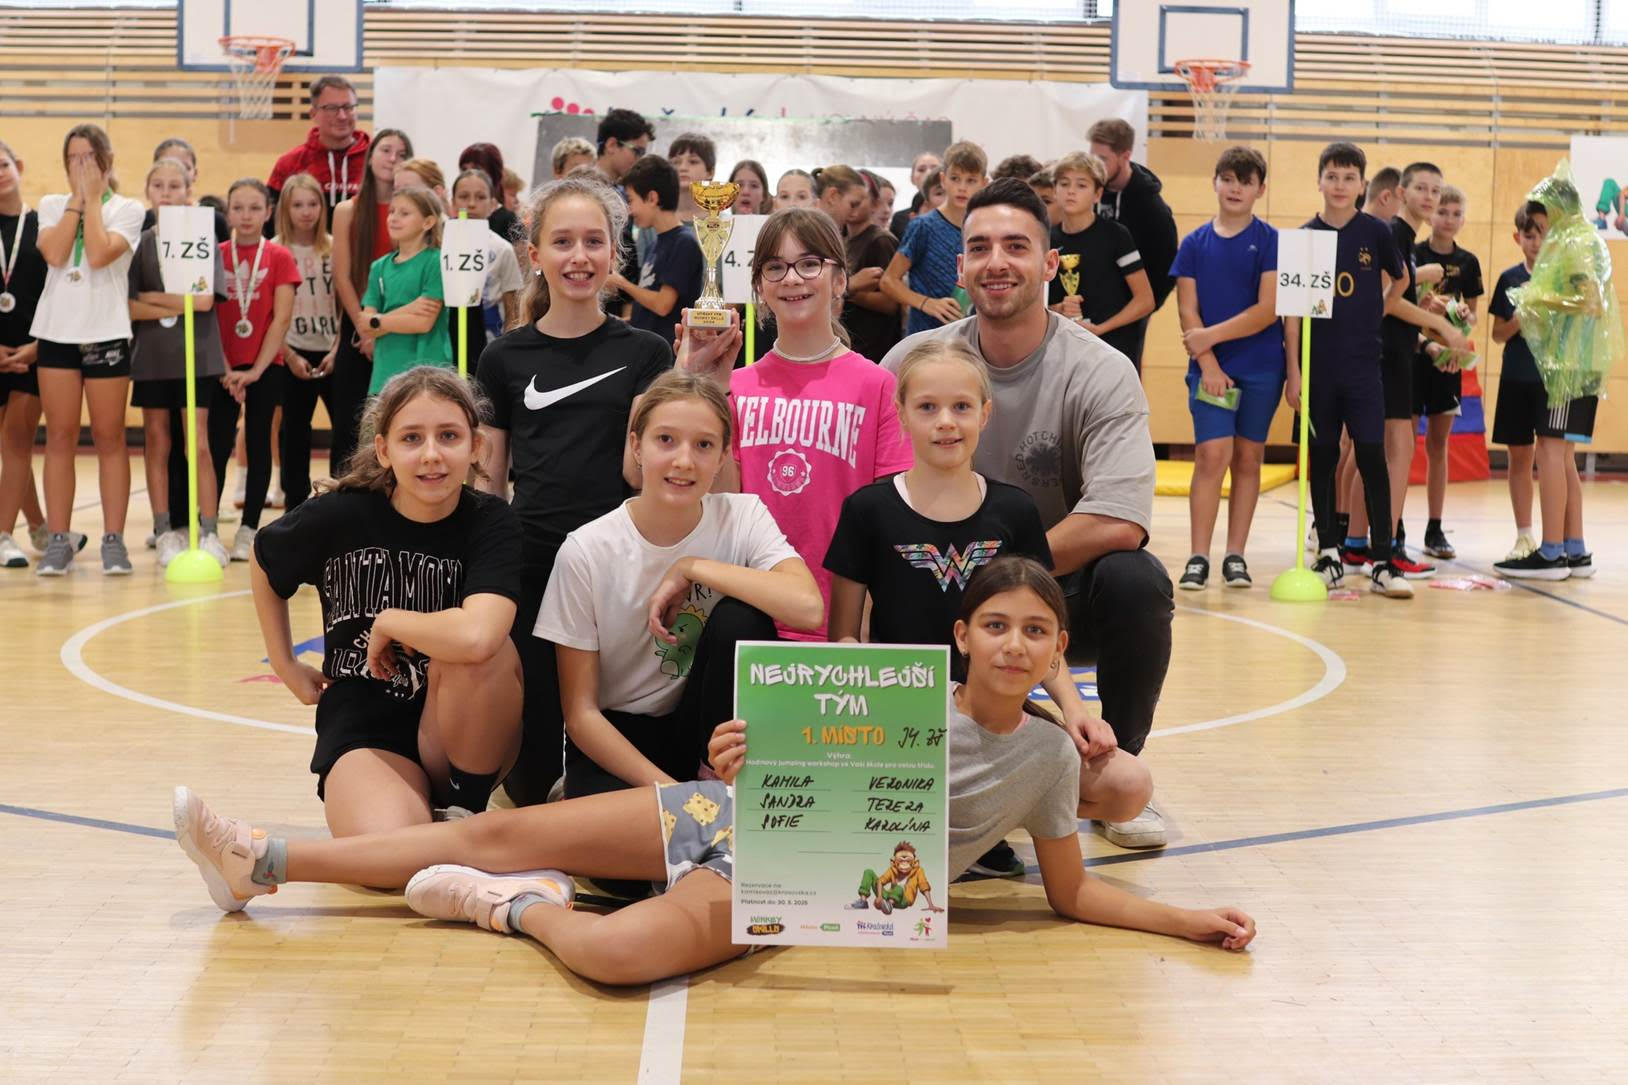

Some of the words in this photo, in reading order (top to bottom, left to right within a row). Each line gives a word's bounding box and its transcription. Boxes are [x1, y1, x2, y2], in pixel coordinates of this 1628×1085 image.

[162, 241, 175, 258] 7.
[180, 238, 210, 259] ZŠ
[458, 249, 484, 271] ZŠ
[1279, 272, 1306, 288] 34.
[1310, 271, 1332, 289] ZŠ
[782, 465, 795, 477] 96
[749, 662, 937, 689] NEJRYCHLEJŠÍ
[813, 690, 870, 717] TÝM
[801, 727, 817, 745] 1.
[761, 774, 815, 788] KAMILA
[868, 776, 935, 791] VERONIKA
[759, 793, 816, 809] SANDRA
[866, 797, 924, 813] TEREZA
[761, 814, 804, 830] SOFIE
